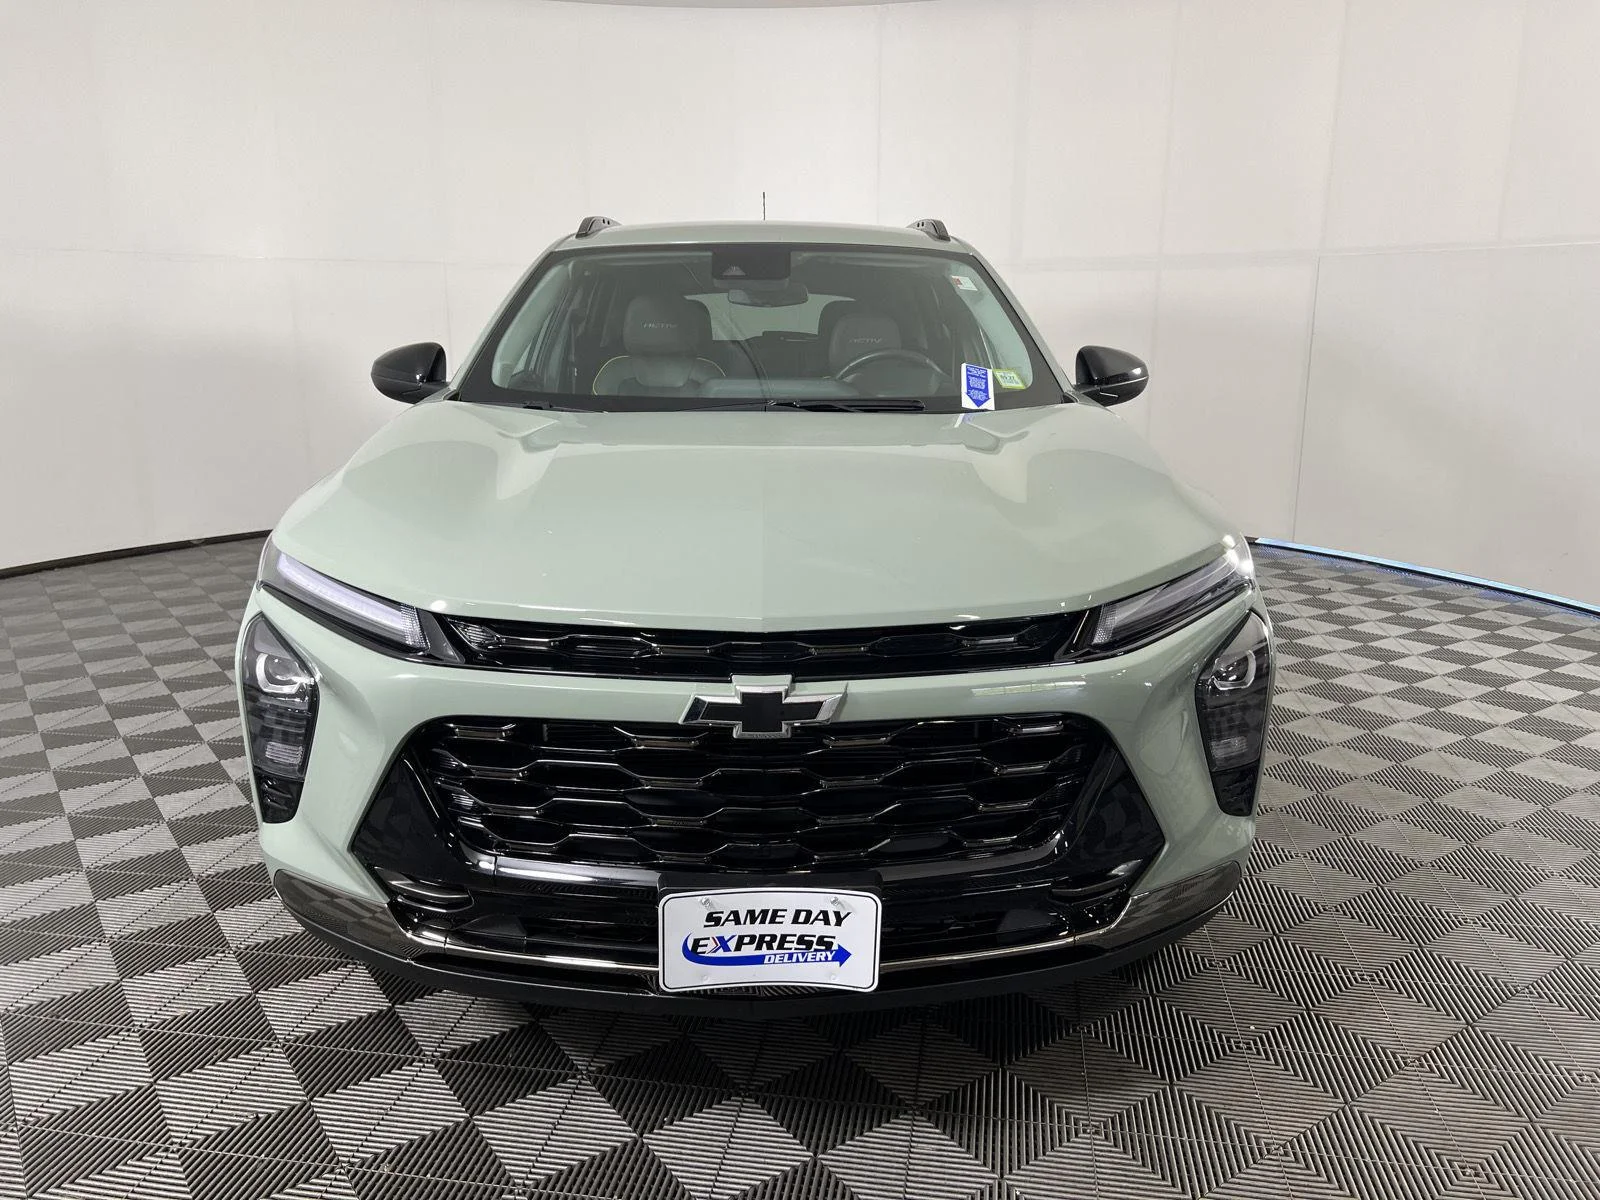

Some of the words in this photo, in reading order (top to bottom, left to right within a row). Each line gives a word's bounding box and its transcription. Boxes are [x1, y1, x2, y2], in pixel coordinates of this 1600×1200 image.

[703, 909, 786, 927] SAME
[791, 909, 852, 927] DAY
[691, 934, 836, 954] EXPRESS
[764, 951, 836, 964] DELIVERY
